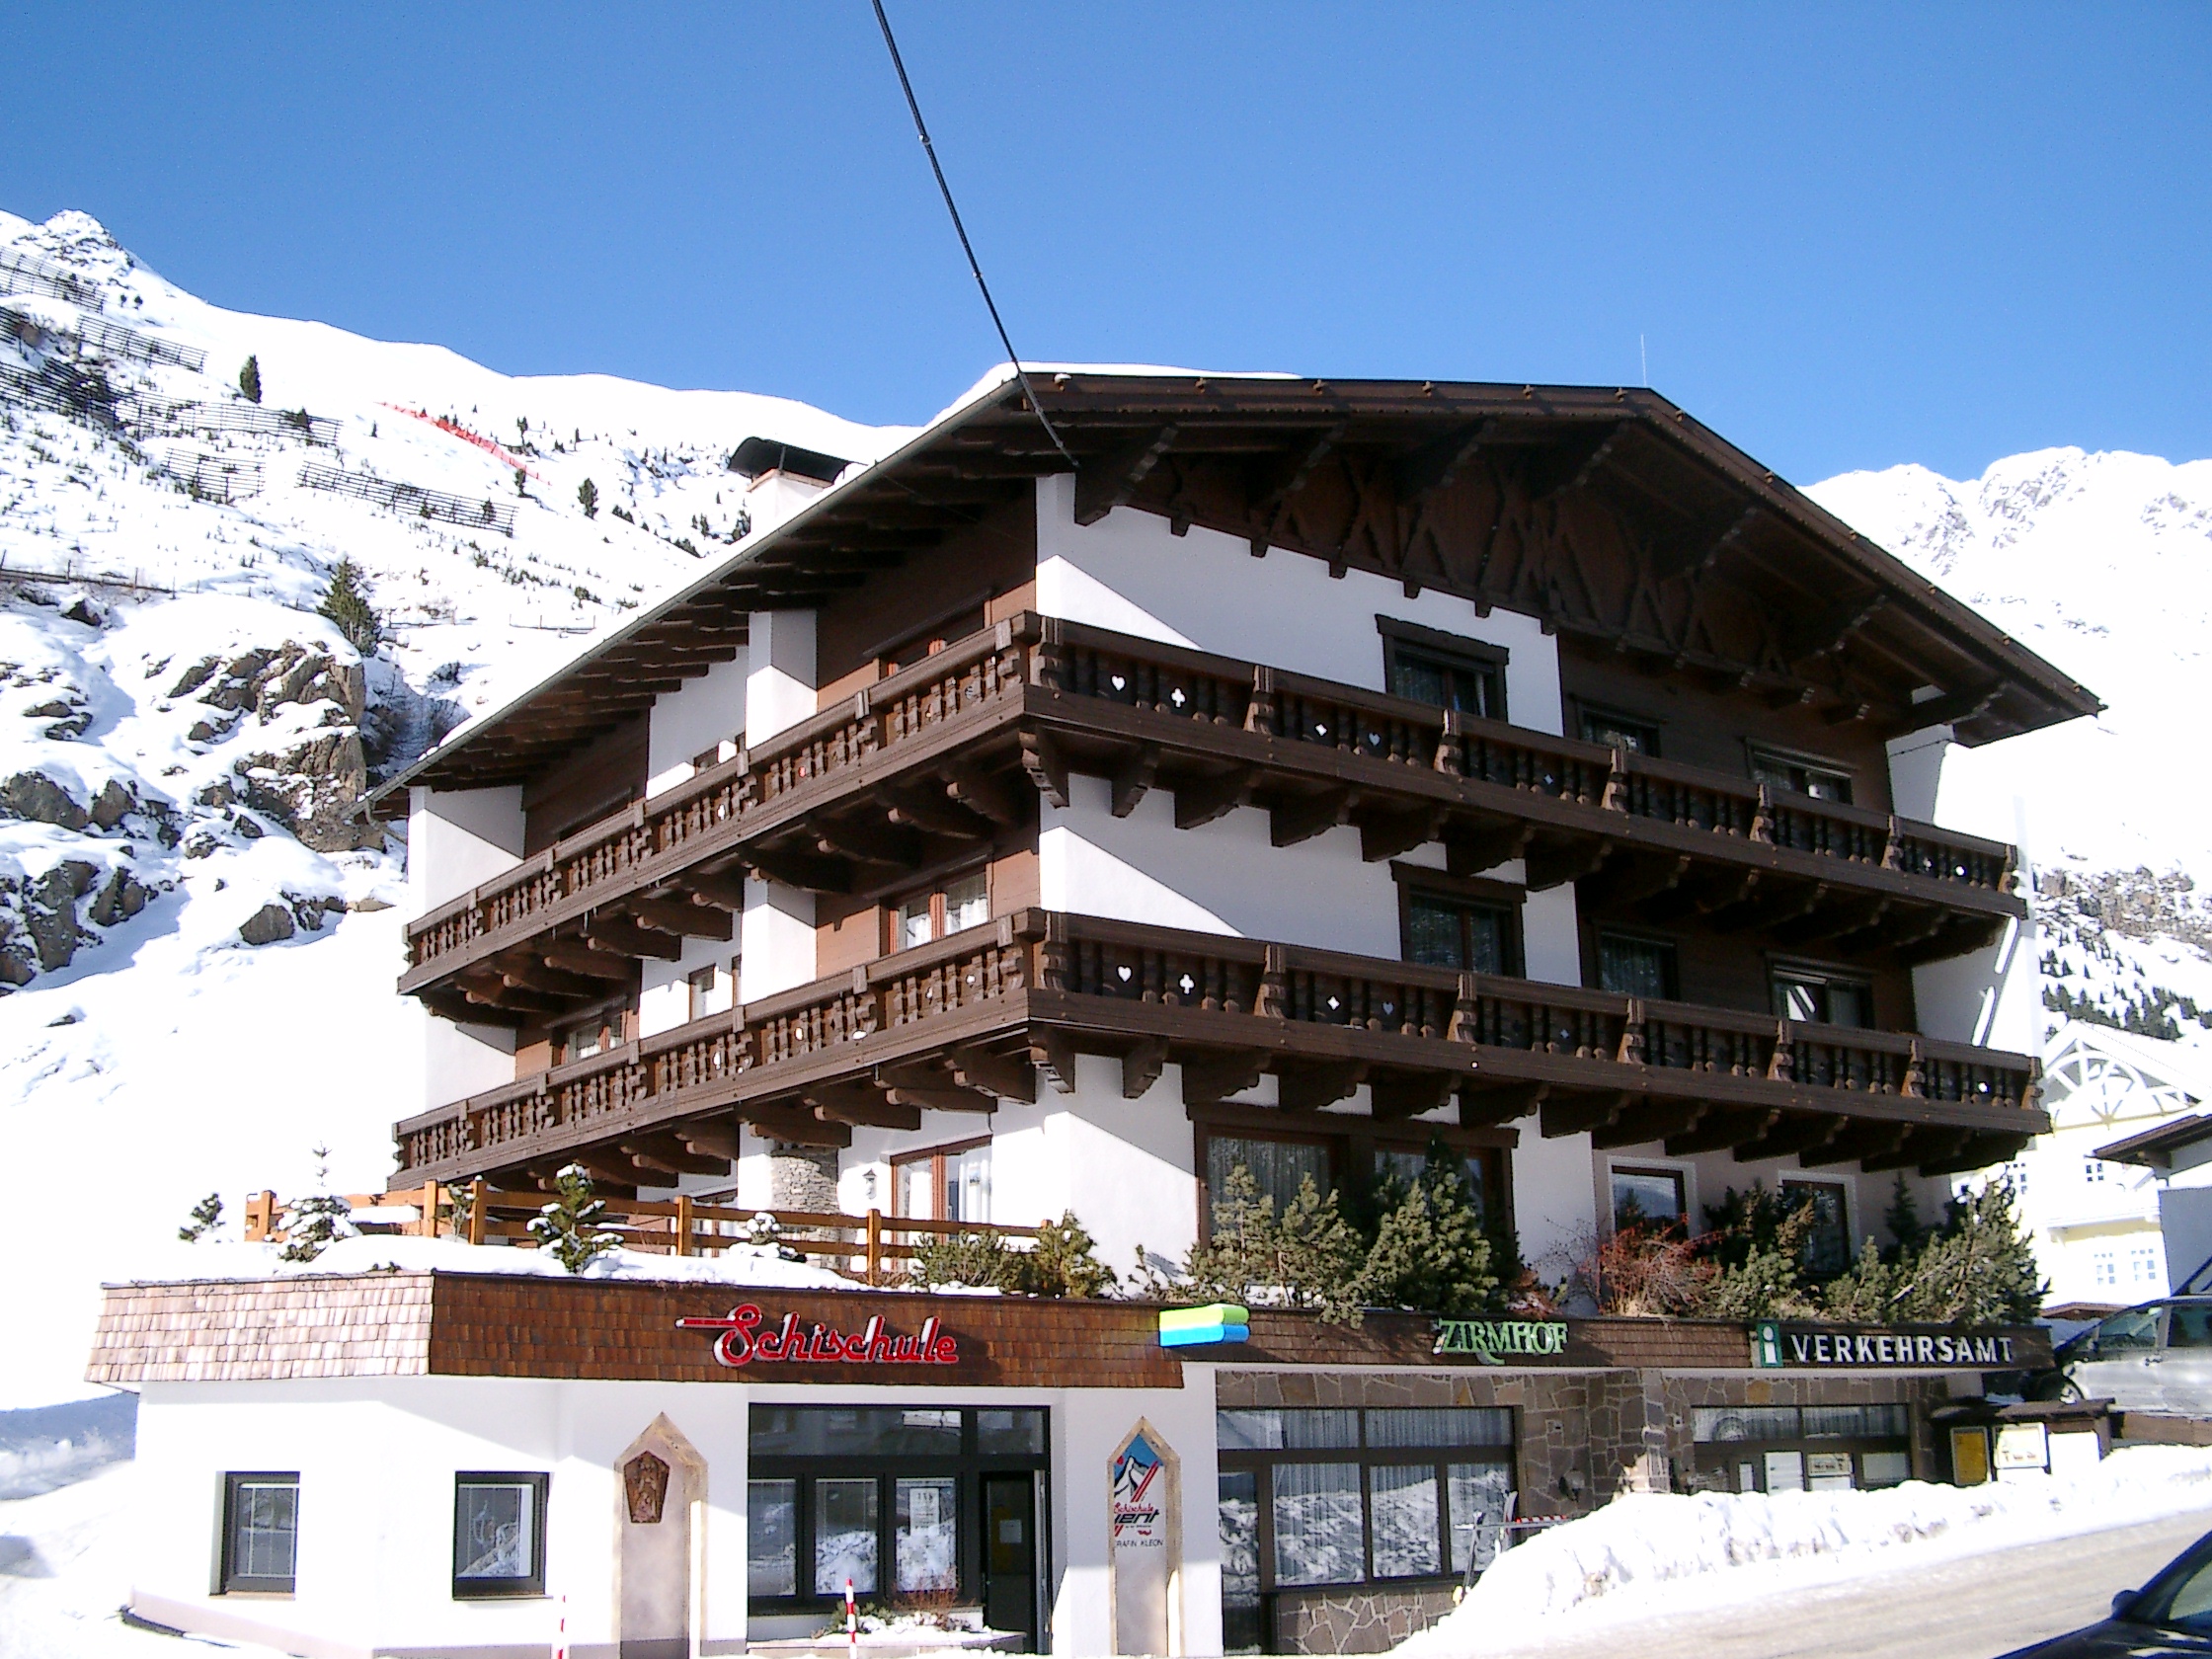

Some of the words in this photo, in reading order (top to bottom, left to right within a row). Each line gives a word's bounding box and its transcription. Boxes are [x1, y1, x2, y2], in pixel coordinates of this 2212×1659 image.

[675, 1303, 959, 1367] Schischule
[1432, 1318, 1568, 1365] ZIRMHOF
[1790, 1333, 2013, 1363] VERKEHRSAMT
